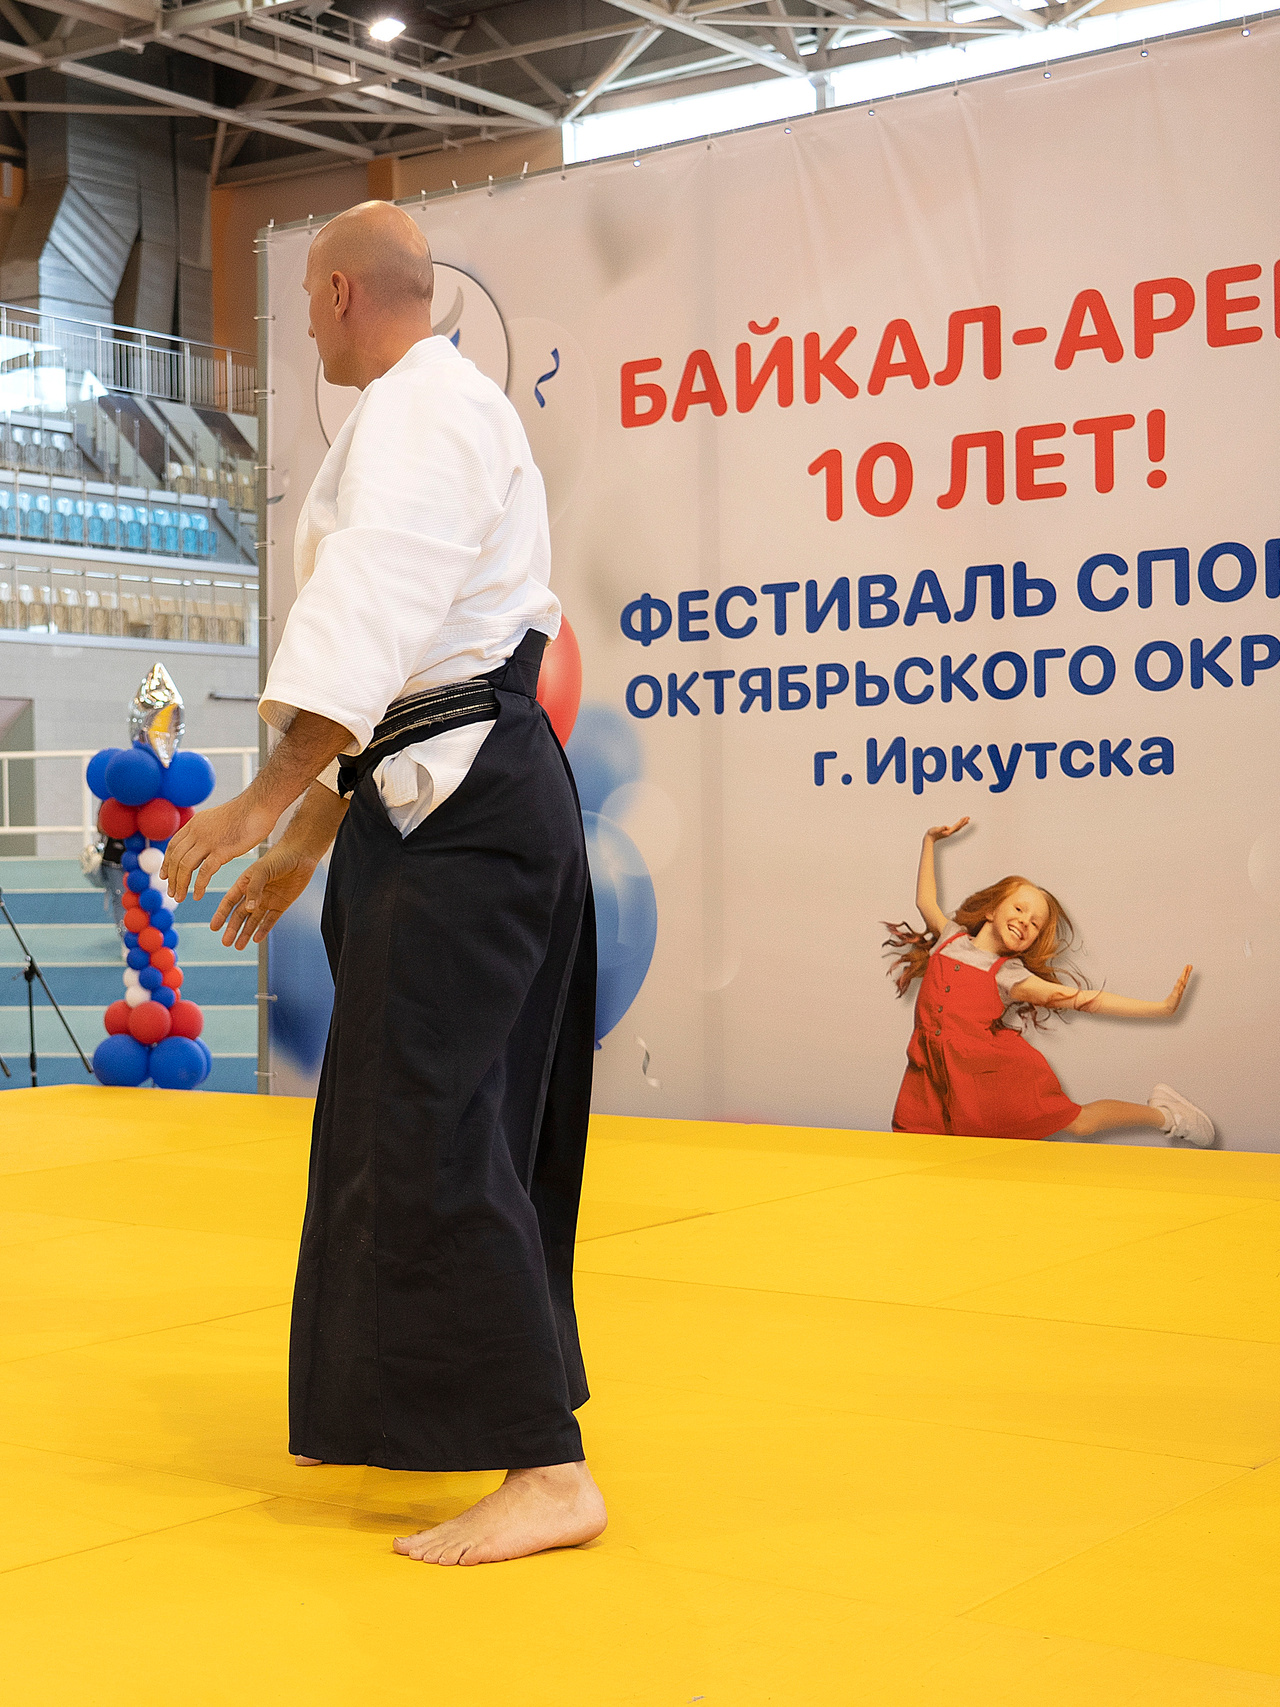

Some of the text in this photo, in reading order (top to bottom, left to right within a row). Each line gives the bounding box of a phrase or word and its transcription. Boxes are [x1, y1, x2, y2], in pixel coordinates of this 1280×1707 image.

[620, 258, 1280, 429] БАЙКАЛ-АРЕ
[807, 408, 1168, 522] 10 ЛЕТ!
[620, 561, 1057, 647] ФЕСТИВАЛЬ
[625, 634, 1280, 719] ОКТЯБРЬСКОГО ОКР
[866, 736, 1174, 795] Иркутска
